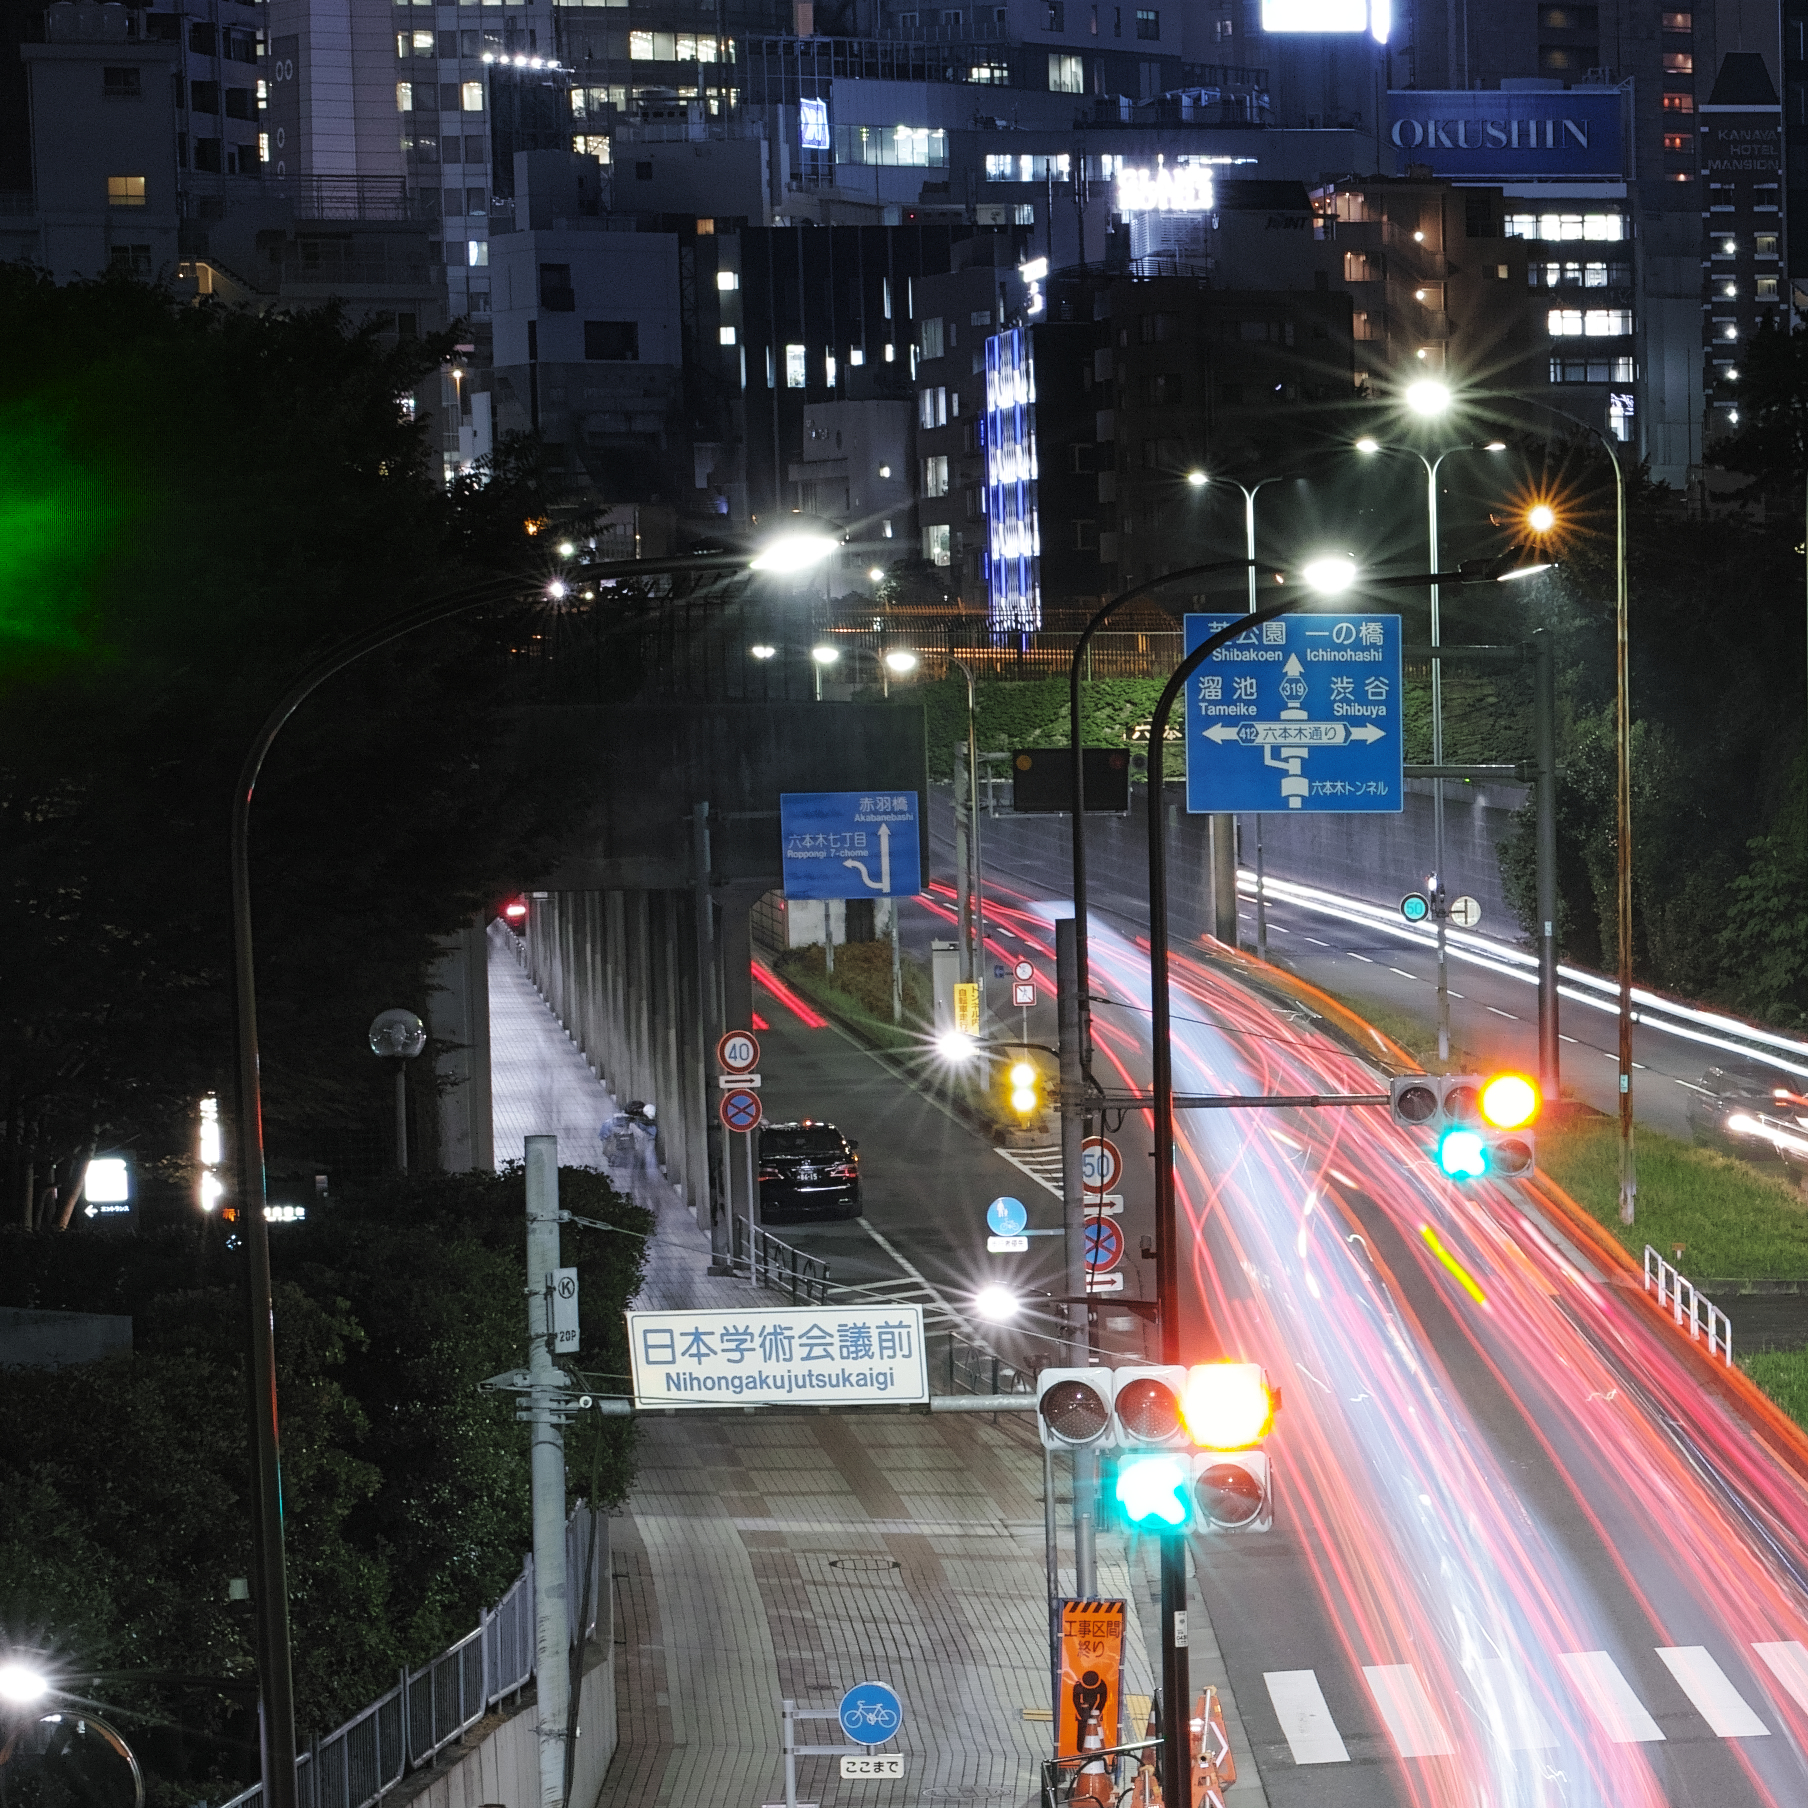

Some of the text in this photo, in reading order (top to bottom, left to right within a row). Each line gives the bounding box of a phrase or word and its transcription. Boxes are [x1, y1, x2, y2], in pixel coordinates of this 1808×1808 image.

[1391, 118, 1589, 150] OKUSHIN
[1718, 130, 1777, 140] KANAYA
[1730, 144, 1779, 156] HOTEL
[1708, 160, 1778, 170] MANSION
[1305, 621, 1385, 646] 一の橋
[1211, 649, 1383, 662] Shibakoen Ichinohashi
[1198, 675, 1390, 701] 溜池 319 渋谷
[1198, 702, 1387, 718] Tameike Shibuya
[1239, 725, 1337, 741] 412 六本木通り
[1311, 781, 1389, 796] 六本木トンネル
[859, 796, 908, 813] 赤羽橋
[854, 813, 914, 823] Akabanebashi
[788, 831, 867, 849] 六本木七丁目
[787, 849, 869, 860] Roppongi 7-chome
[1406, 901, 1423, 916] 50
[728, 1042, 750, 1062] 40
[1082, 1154, 1109, 1177] 50
[559, 1329, 577, 1342] 20P
[642, 1320, 913, 1366] 日本学術会議前
[665, 1366, 896, 1395] Nihongakujutsukaigi
[1064, 1619, 1121, 1639] 工事区間
[1077, 1640, 1105, 1659] 終り
[846, 1760, 899, 1774] ここまで
